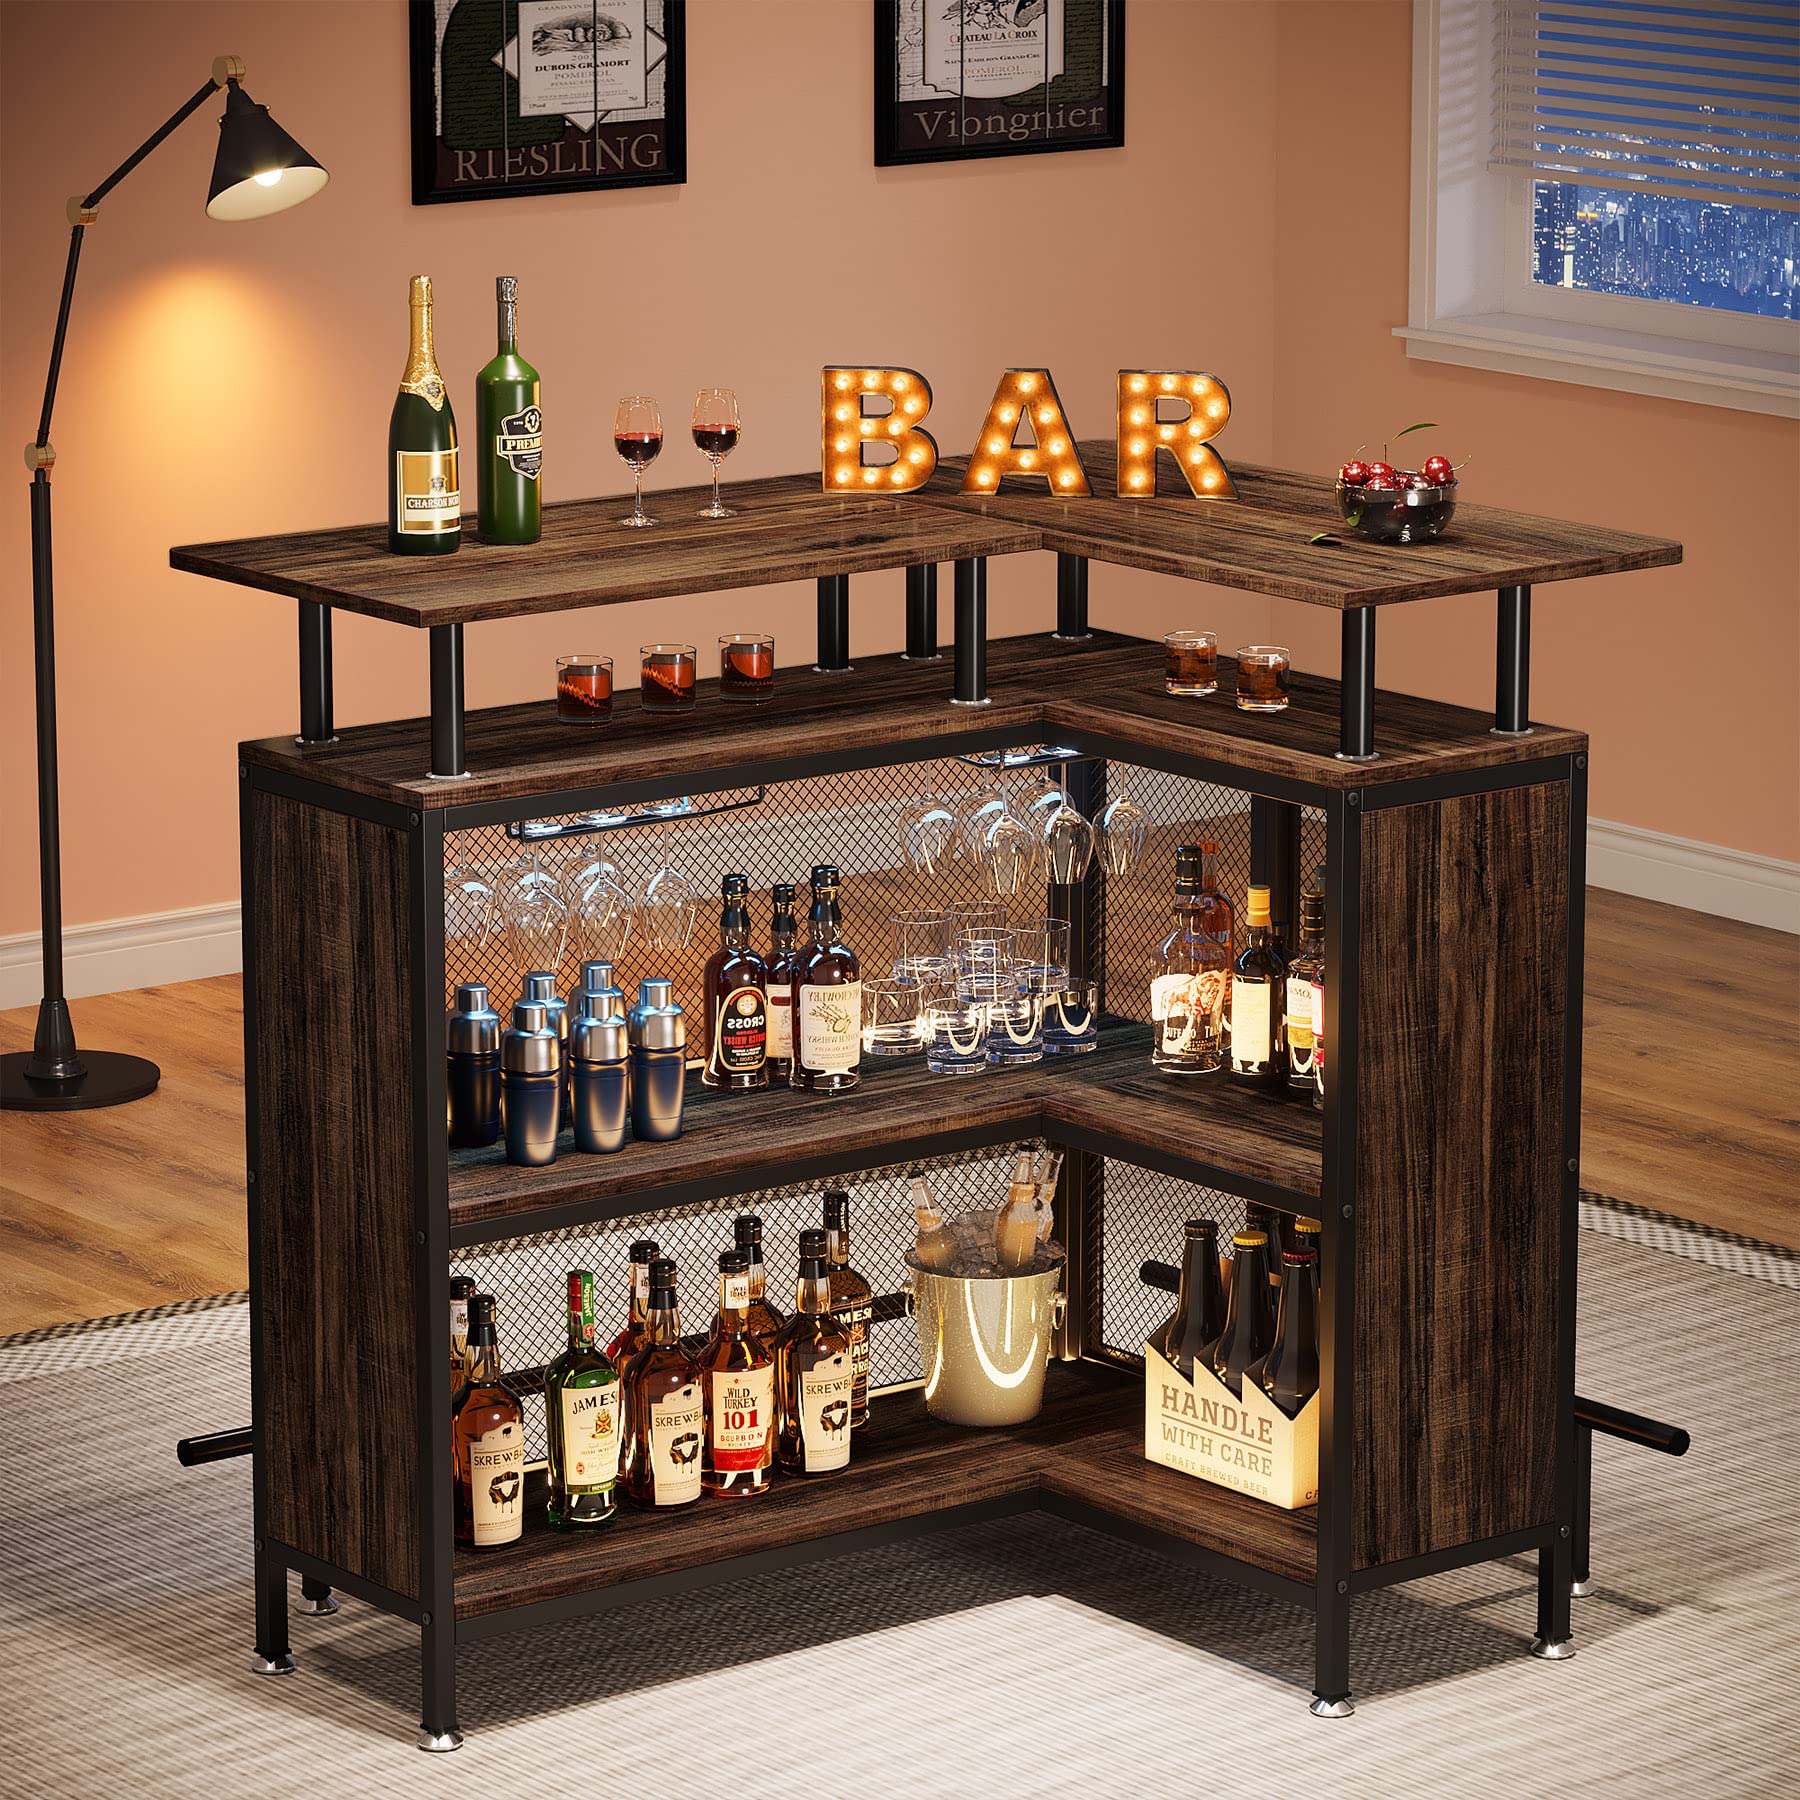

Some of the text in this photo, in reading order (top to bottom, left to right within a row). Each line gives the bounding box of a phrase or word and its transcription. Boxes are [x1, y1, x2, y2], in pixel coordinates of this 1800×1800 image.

[1007, 29, 1038, 40] CROIX
[535, 63, 576, 72] DUBOIS
[454, 134, 662, 182] RIESLING
[822, 365, 1240, 499] BAR
[408, 497, 447, 509] CHARSON
[583, 1283, 593, 1317] JAMESON
[572, 1390, 618, 1415] JAMES
[723, 1396, 758, 1409] TURKEY
[727, 1387, 750, 1398] WILD
[723, 1409, 760, 1430] 101
[1161, 1383, 1273, 1445] HANDLE
[721, 1431, 763, 1442] BOURBON
[1161, 1422, 1273, 1477] WITH CARE
[1165, 1452, 1268, 1496] CRAFT BREWED BEER
